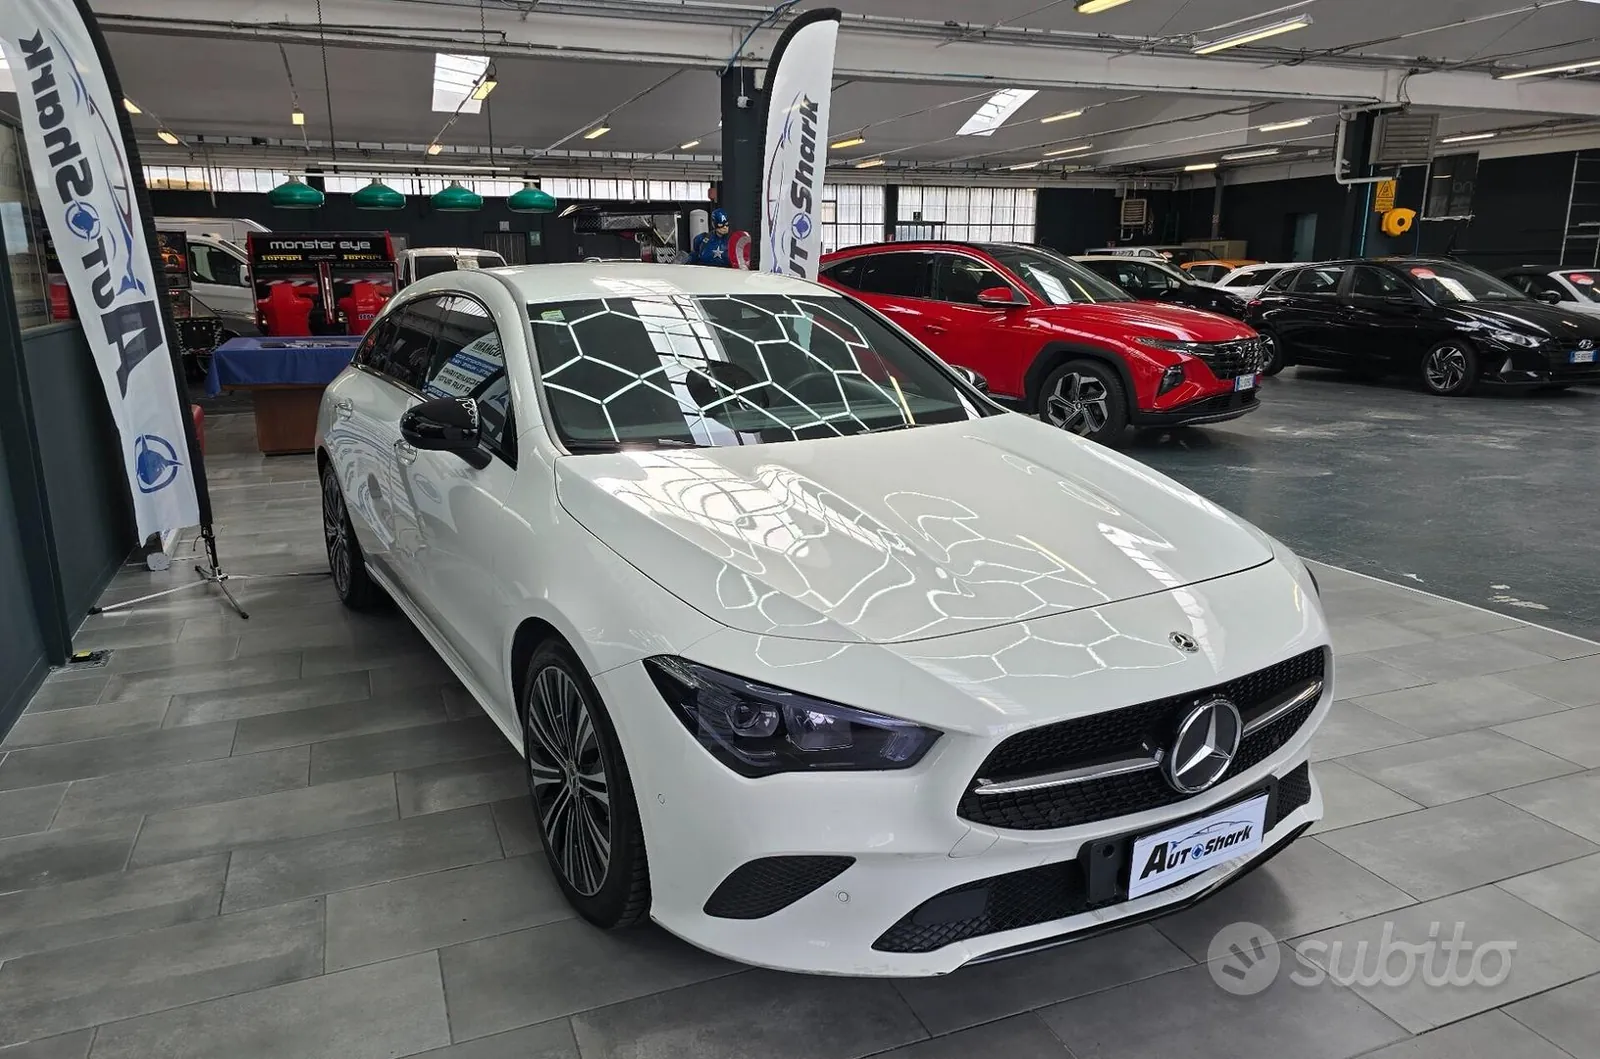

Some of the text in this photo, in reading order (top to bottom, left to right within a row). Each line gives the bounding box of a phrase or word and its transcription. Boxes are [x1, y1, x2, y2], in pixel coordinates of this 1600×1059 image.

[789, 94, 819, 279] UTOShark
[270, 238, 371, 251] monster eye
